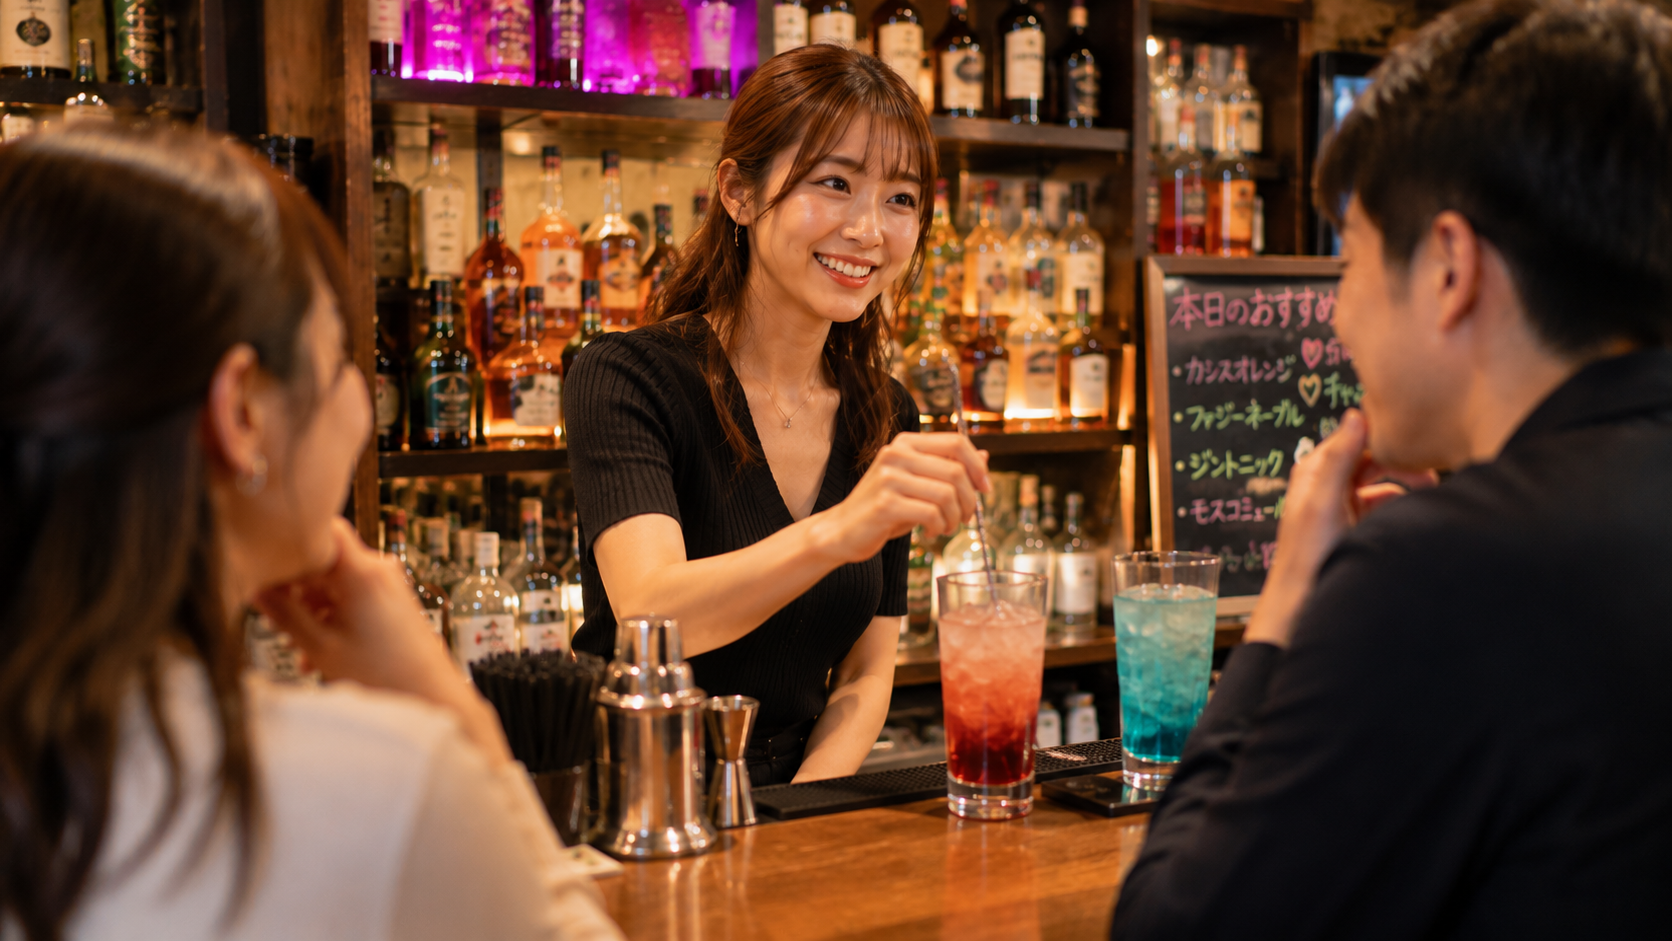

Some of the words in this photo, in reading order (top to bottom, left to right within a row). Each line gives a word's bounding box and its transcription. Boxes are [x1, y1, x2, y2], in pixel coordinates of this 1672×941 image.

[1169, 286, 1336, 331] 本日のおすすめ
[1185, 354, 1297, 385] カシスオレンジ
[1189, 448, 1285, 481] ジントニック
